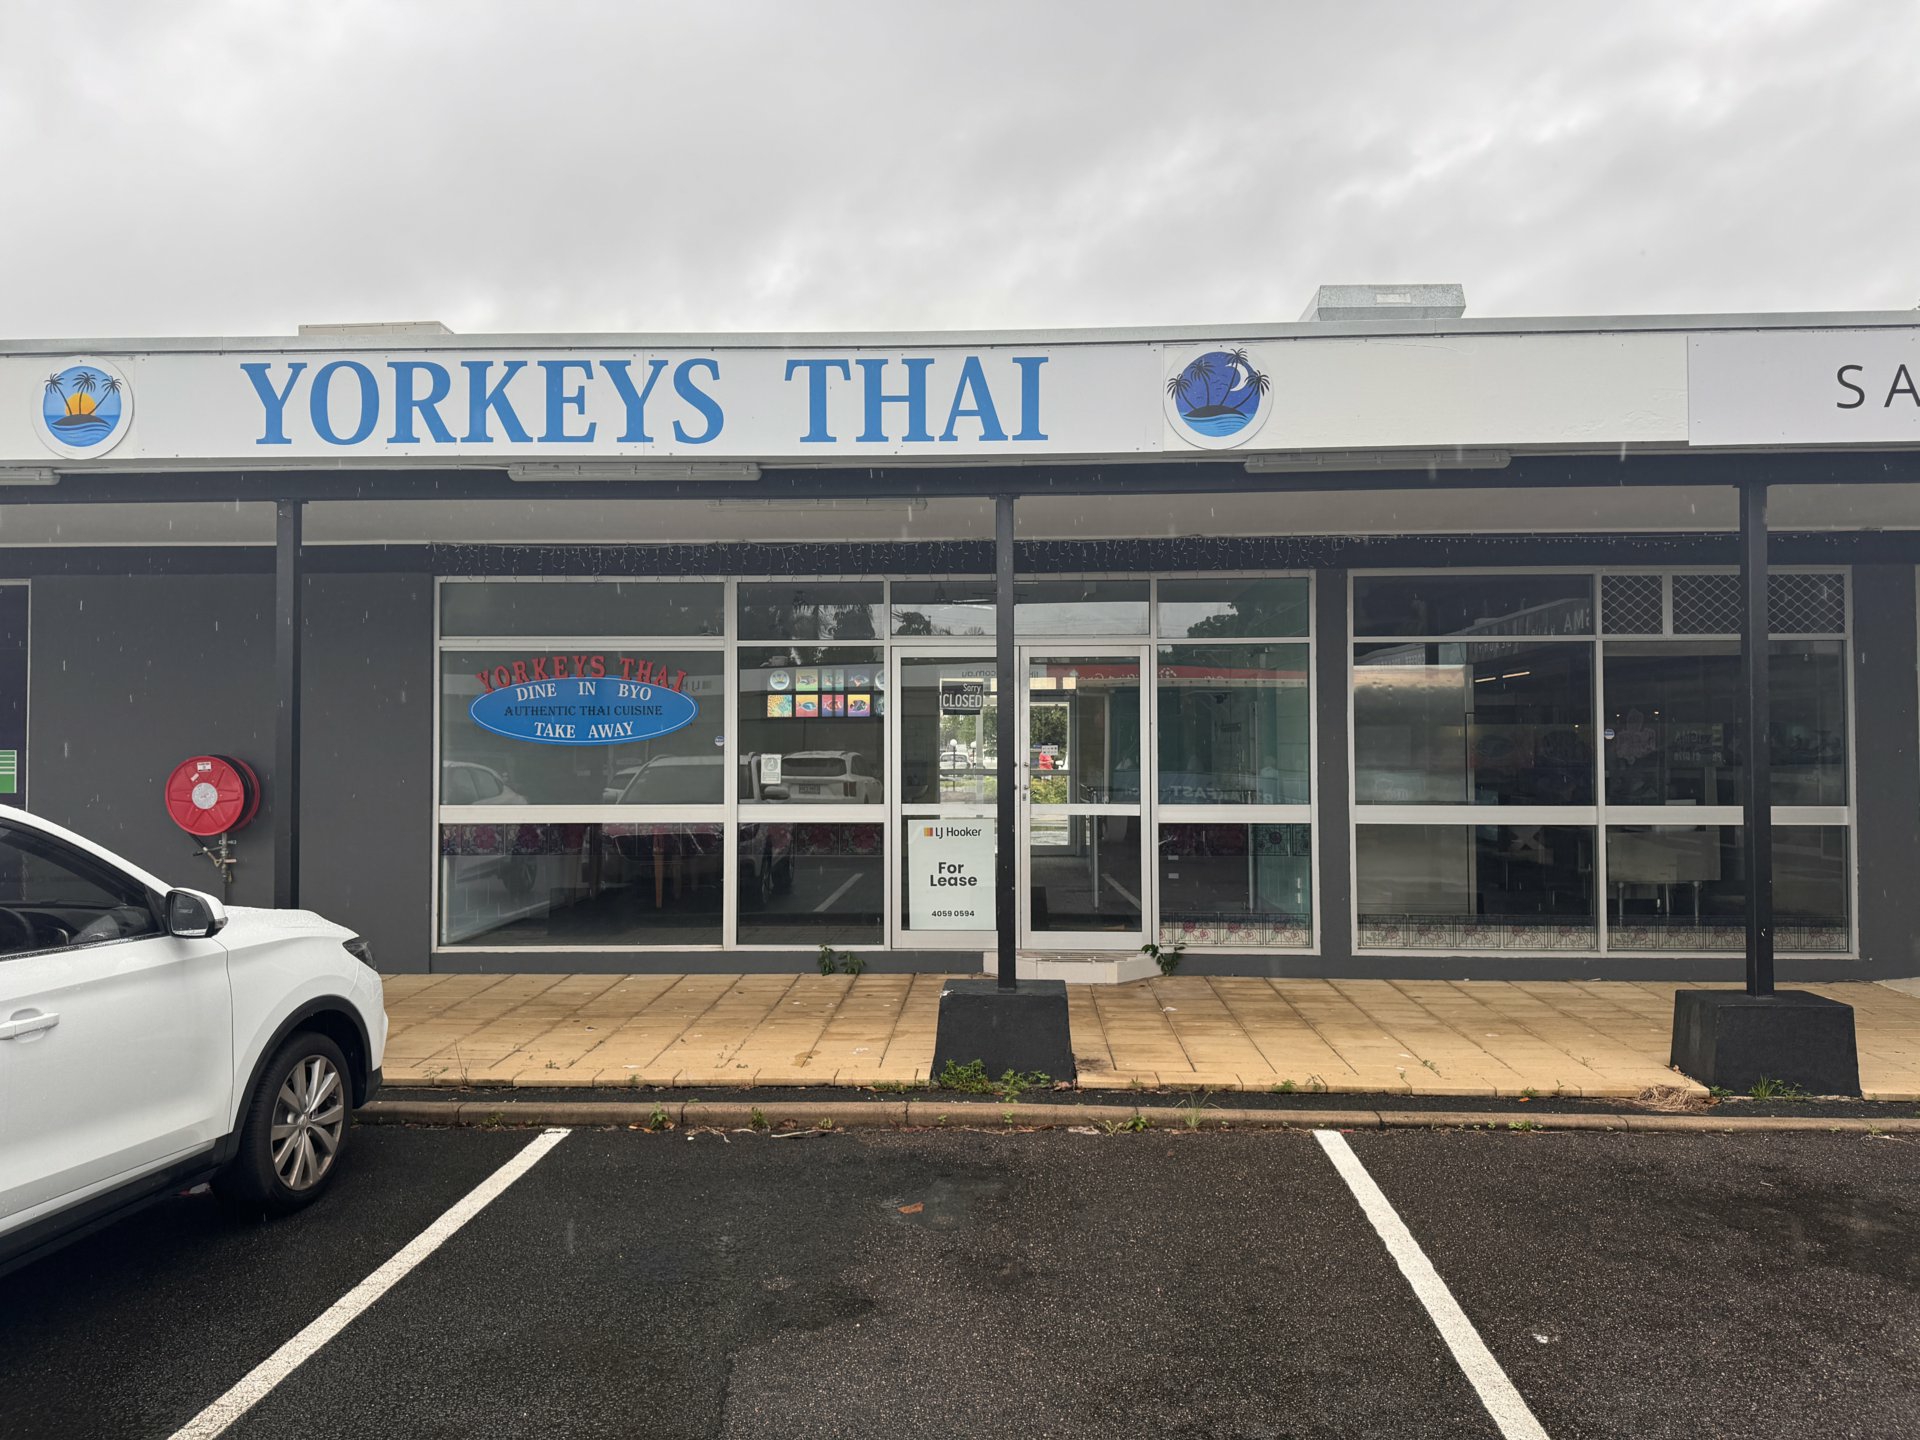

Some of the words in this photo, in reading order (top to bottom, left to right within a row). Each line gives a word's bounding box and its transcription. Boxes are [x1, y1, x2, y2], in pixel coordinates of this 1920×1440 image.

[241, 359, 724, 446] YORKEYS
[785, 356, 1048, 443] THAI
[475, 655, 607, 693] YORKEYS
[618, 656, 689, 693] THAI
[515, 682, 557, 702] DINE
[578, 681, 597, 695] IN
[618, 683, 652, 701] BYO
[963, 683, 983, 695] Sorry
[942, 694, 982, 707] CLOSED
[504, 705, 576, 716] AUTHENTIC
[579, 705, 611, 716] THAI
[613, 705, 663, 716] CUISINE
[534, 721, 576, 738] TAKE
[588, 721, 634, 738] AWAY
[935, 827, 943, 839] LJ
[946, 827, 982, 837] Hooker
[938, 862, 964, 874] For
[930, 875, 978, 887] Lease
